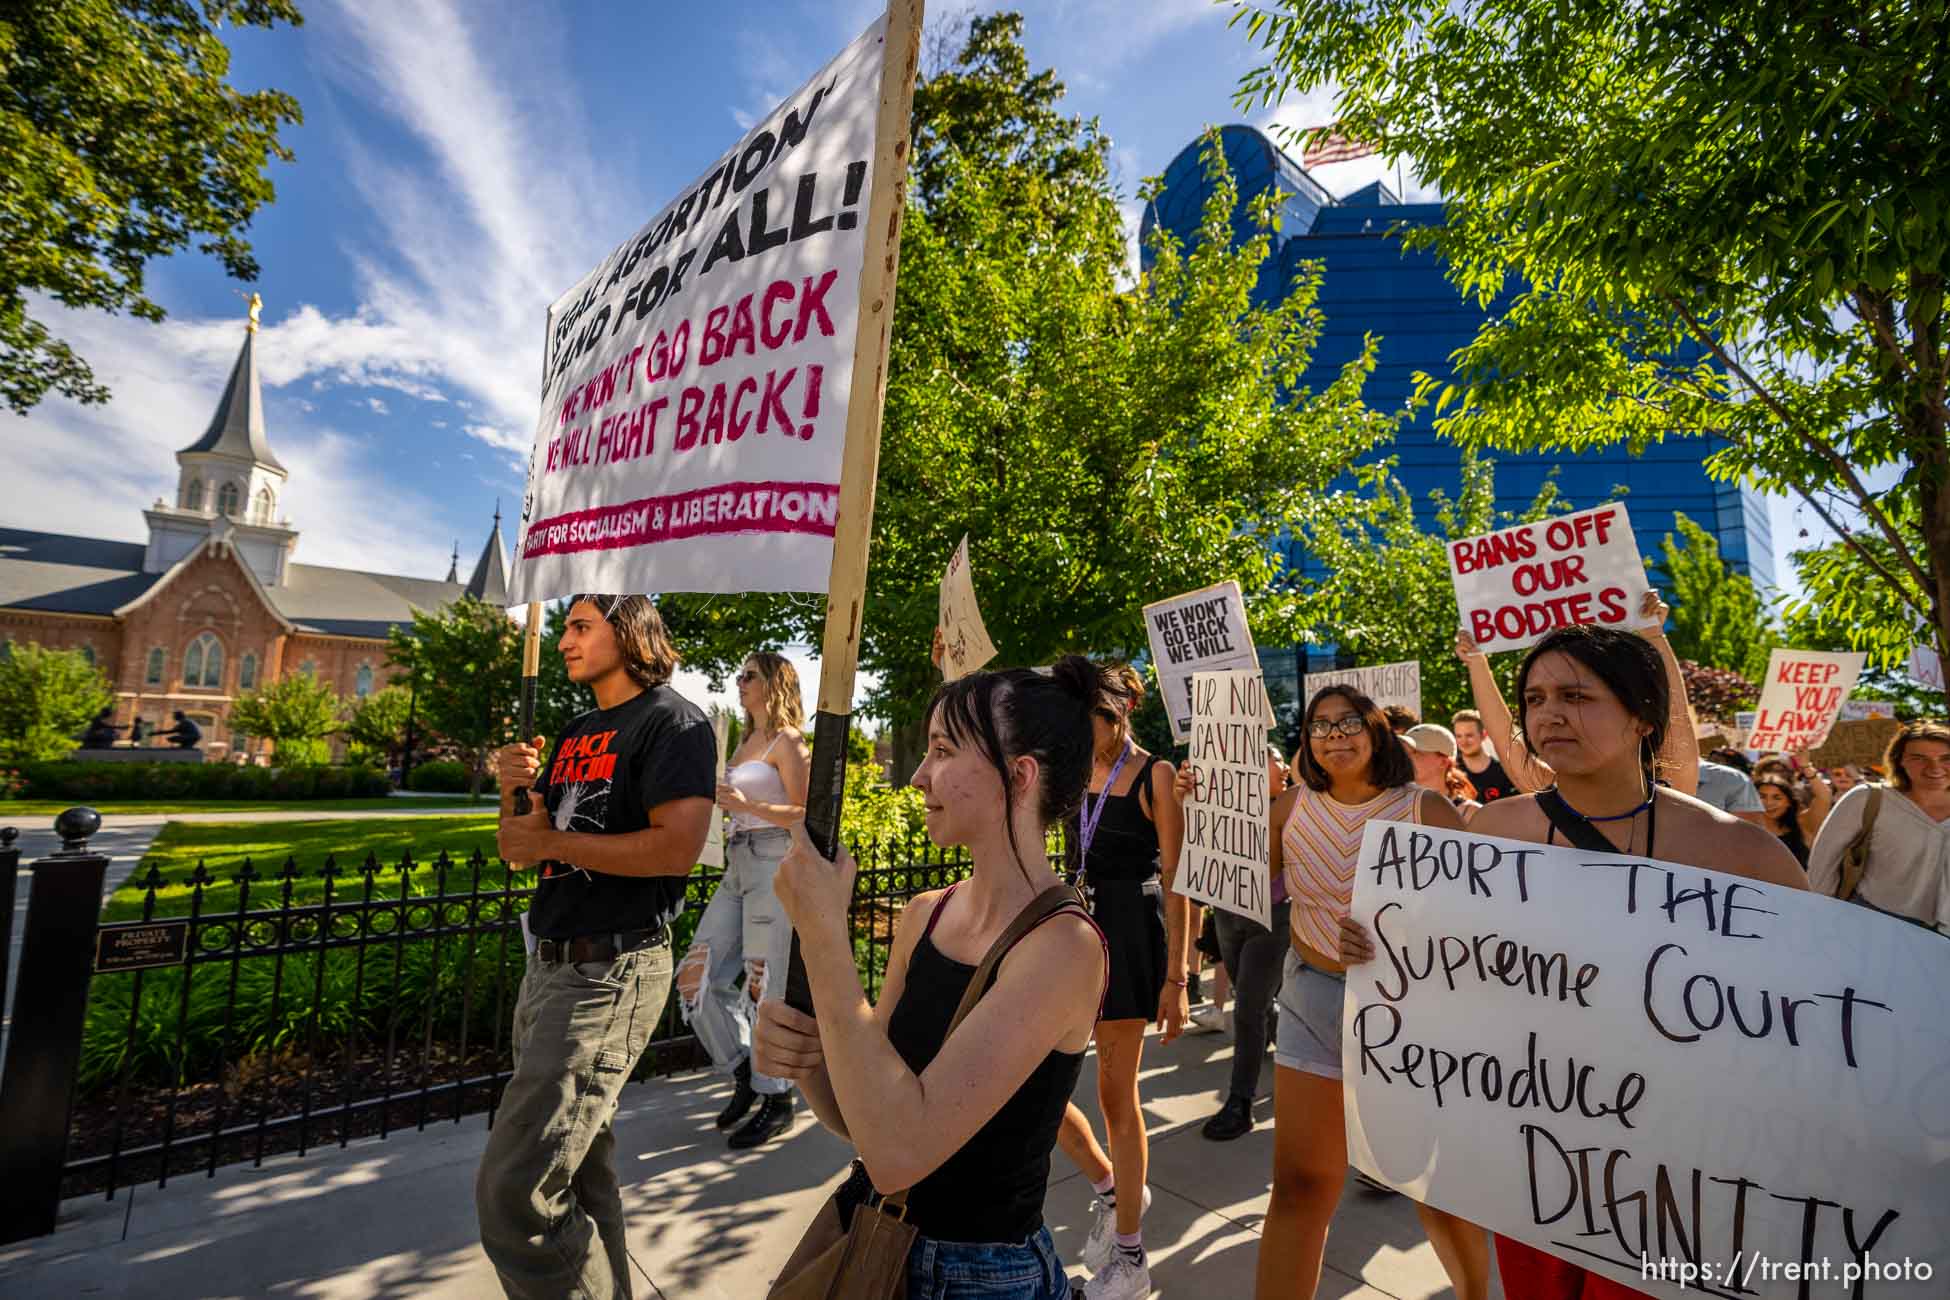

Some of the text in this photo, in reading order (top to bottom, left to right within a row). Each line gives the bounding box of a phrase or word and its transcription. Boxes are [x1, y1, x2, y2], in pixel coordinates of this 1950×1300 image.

[557, 160, 867, 376] AND FOR ALL!
[560, 384, 584, 424] WE
[582, 344, 645, 411] WON'T
[646, 319, 690, 383] GO
[699, 270, 838, 367] BACK
[545, 364, 823, 473] WE WILL FIGHT BACK!
[548, 522, 569, 547] FOR
[569, 505, 649, 544] SOCIALISM
[652, 506, 665, 531] &
[669, 489, 839, 529] LIBERATION
[1453, 510, 1616, 575] BANS OFF
[1512, 555, 1588, 597] OUR
[1154, 596, 1229, 632] WE WON'T
[1163, 616, 1230, 647] GO BACK
[1470, 587, 1627, 643] BODIES
[1166, 635, 1235, 664] WE WILL
[1777, 661, 1840, 683] KEEP
[1196, 678, 1217, 716] UR
[1230, 675, 1263, 717] NOT
[1374, 664, 1418, 698] RIGHTS
[1795, 686, 1843, 712] YOUR
[557, 729, 619, 758] BLACK
[1193, 722, 1265, 769] SAVING
[1757, 709, 1831, 733] LAWS
[1193, 765, 1265, 818] BABIES
[1186, 807, 1269, 865] UR KILLING
[1187, 850, 1264, 915] WOMEN
[1370, 827, 1779, 939] ABORT THE
[1374, 902, 1599, 1008] Supreme
[1354, 1004, 1645, 1128] Reproduce
[1520, 1124, 1899, 1300] DIGNITY
